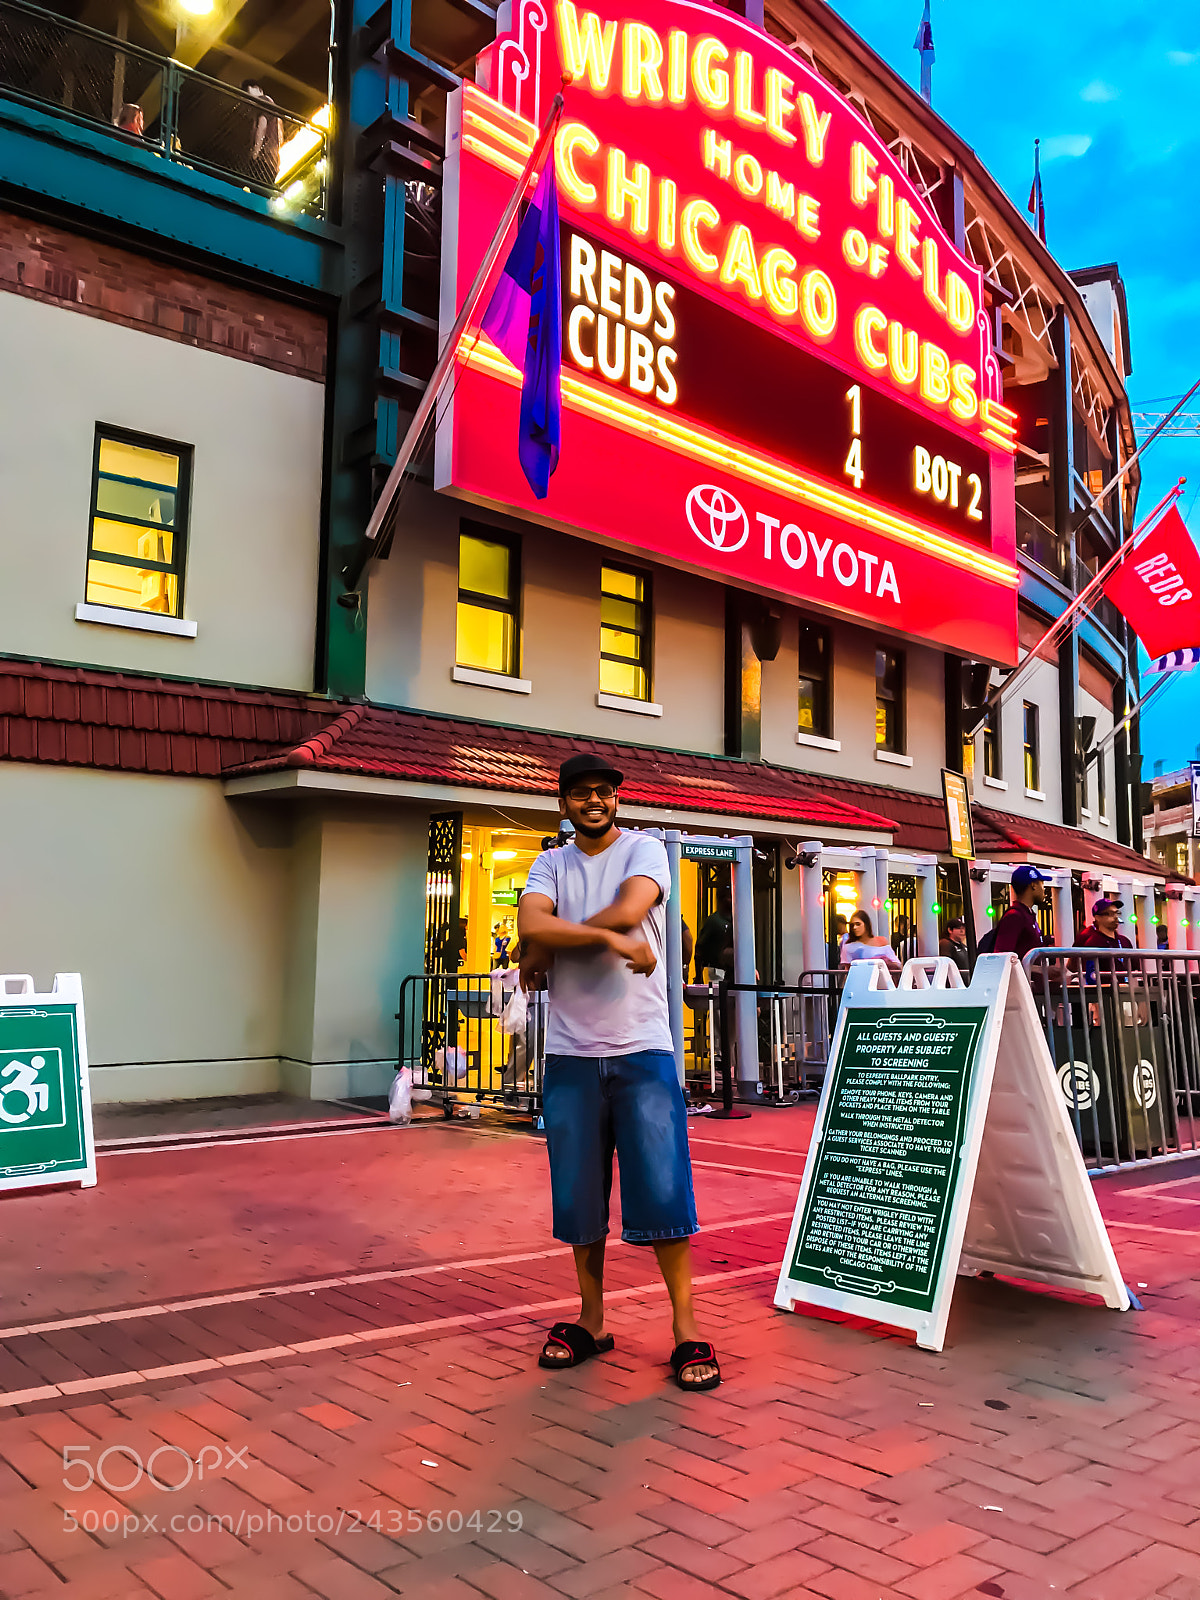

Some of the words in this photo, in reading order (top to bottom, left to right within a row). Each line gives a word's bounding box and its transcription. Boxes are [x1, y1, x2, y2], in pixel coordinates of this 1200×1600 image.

[557, 0, 832, 163] WRIGLEY
[851, 141, 975, 332] FIELD
[704, 128, 821, 238] HOME
[842, 229, 890, 277] OF
[555, 122, 837, 337] CHICAGO
[855, 306, 978, 419] CUBS
[571, 233, 675, 340] REDS
[569, 304, 678, 404] CUBS
[846, 384, 861, 435] 1
[845, 438, 864, 488] 4
[915, 445, 962, 508] BOT
[967, 473, 982, 520] 2
[755, 512, 902, 605] TOYOTA
[1134, 552, 1193, 606] REDS
[686, 847, 714, 855] EXPRESS
[716, 849, 733, 857] LANE
[856, 1045, 897, 1054] PROPERTY
[897, 1046, 915, 1054] ARE
[915, 1046, 952, 1054] SUBJECT
[871, 1058, 881, 1066] TO
[883, 1059, 929, 1067] SCREENING
[879, 1122, 914, 1131] INSTRUCTED
[913, 1118, 944, 1127] DETECTOR
[864, 1132, 898, 1141] BELONGINGS
[913, 1137, 942, 1146] PROCEED
[873, 1139, 904, 1149] ASSOCIATE
[933, 1146, 951, 1154] YOUR
[880, 1148, 907, 1156] SCANNED
[898, 1164, 919, 1172] PLEASE
[826, 1186, 849, 1196] REQUEST
[859, 1191, 891, 1203] ALTERNATE
[837, 1181, 864, 1190] DETECTOR
[918, 1193, 941, 1203] PLEASE
[852, 1176, 874, 1185] UNABLE
[884, 1180, 900, 1189] WALK
[902, 1183, 932, 1194] THROUGH
[816, 1214, 836, 1223] POSTED
[857, 1222, 869, 1230] YOU
[883, 1226, 913, 1237] CARRYING
[915, 1231, 928, 1240] ANY
[824, 1208, 855, 1218] RESTRICTED
[877, 1217, 898, 1226] PLEASE
[899, 1220, 922, 1230] REVIEW
[924, 1225, 935, 1234] THE
[854, 1206, 871, 1214] ENTER
[873, 1207, 898, 1218] WRIGLEY
[899, 1212, 916, 1222] FIELD
[918, 1216, 933, 1225] WITH
[812, 1221, 842, 1232] RESTRICTED
[861, 1229, 883, 1239] PLEASE
[884, 1233, 901, 1243] LEAVE
[903, 1238, 915, 1246] THE
[916, 1240, 930, 1249] LINE
[822, 1230, 843, 1239] RETURN
[853, 1235, 868, 1244] YOUR
[892, 1244, 928, 1256] OTHERWISE
[805, 1243, 821, 1251] GATES
[822, 1245, 833, 1253] ARE
[834, 1248, 845, 1256] NOT
[847, 1250, 857, 1258] THE
[858, 1252, 904, 1268] RESPONSIBILITY
[906, 1262, 914, 1270] OF
[916, 1264, 927, 1274] THE
[806, 1234, 828, 1245] DISPOSE
[838, 1240, 854, 1250] THESE
[874, 1248, 891, 1258] ITEMS
[917, 1257, 929, 1266] THE
[840, 1257, 866, 1268] CHICAGO
